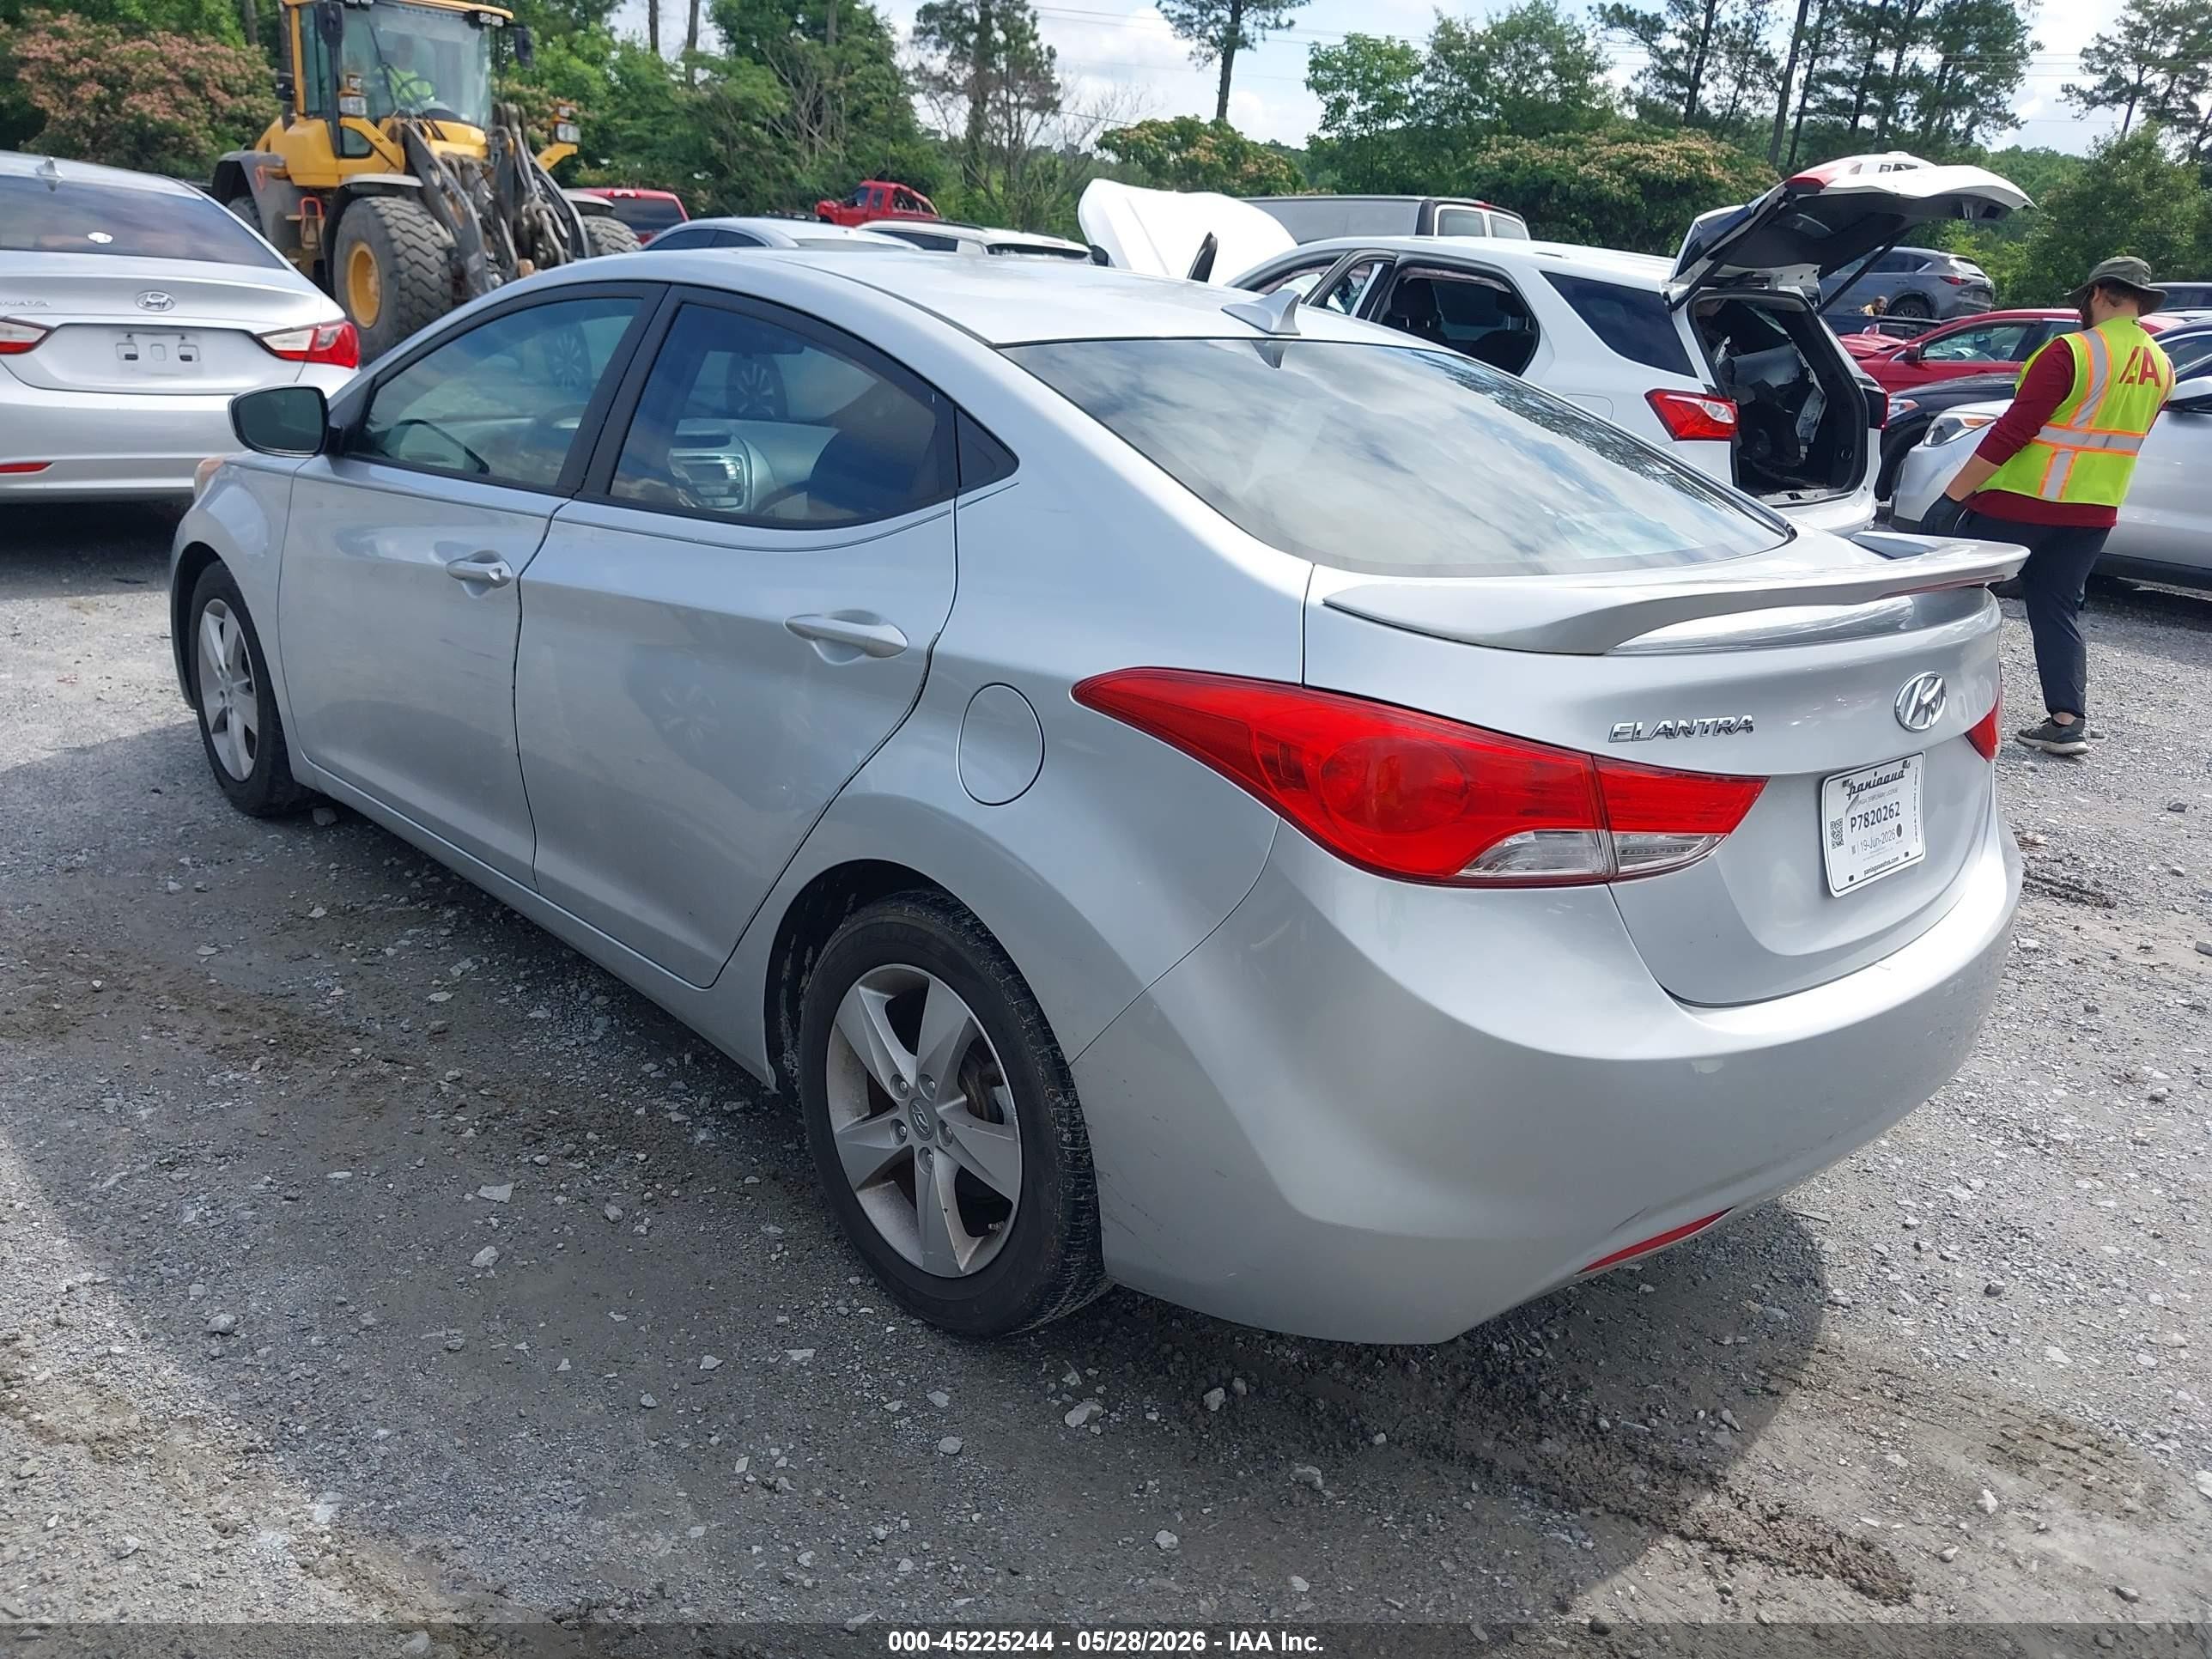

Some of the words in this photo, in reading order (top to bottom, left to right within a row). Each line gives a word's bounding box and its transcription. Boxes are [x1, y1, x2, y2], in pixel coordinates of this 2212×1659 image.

[1608, 714, 1755, 743] ELANTRA
[1850, 801, 1900, 833] P7820262
[1861, 828, 1896, 852] 19-Jun-2026
